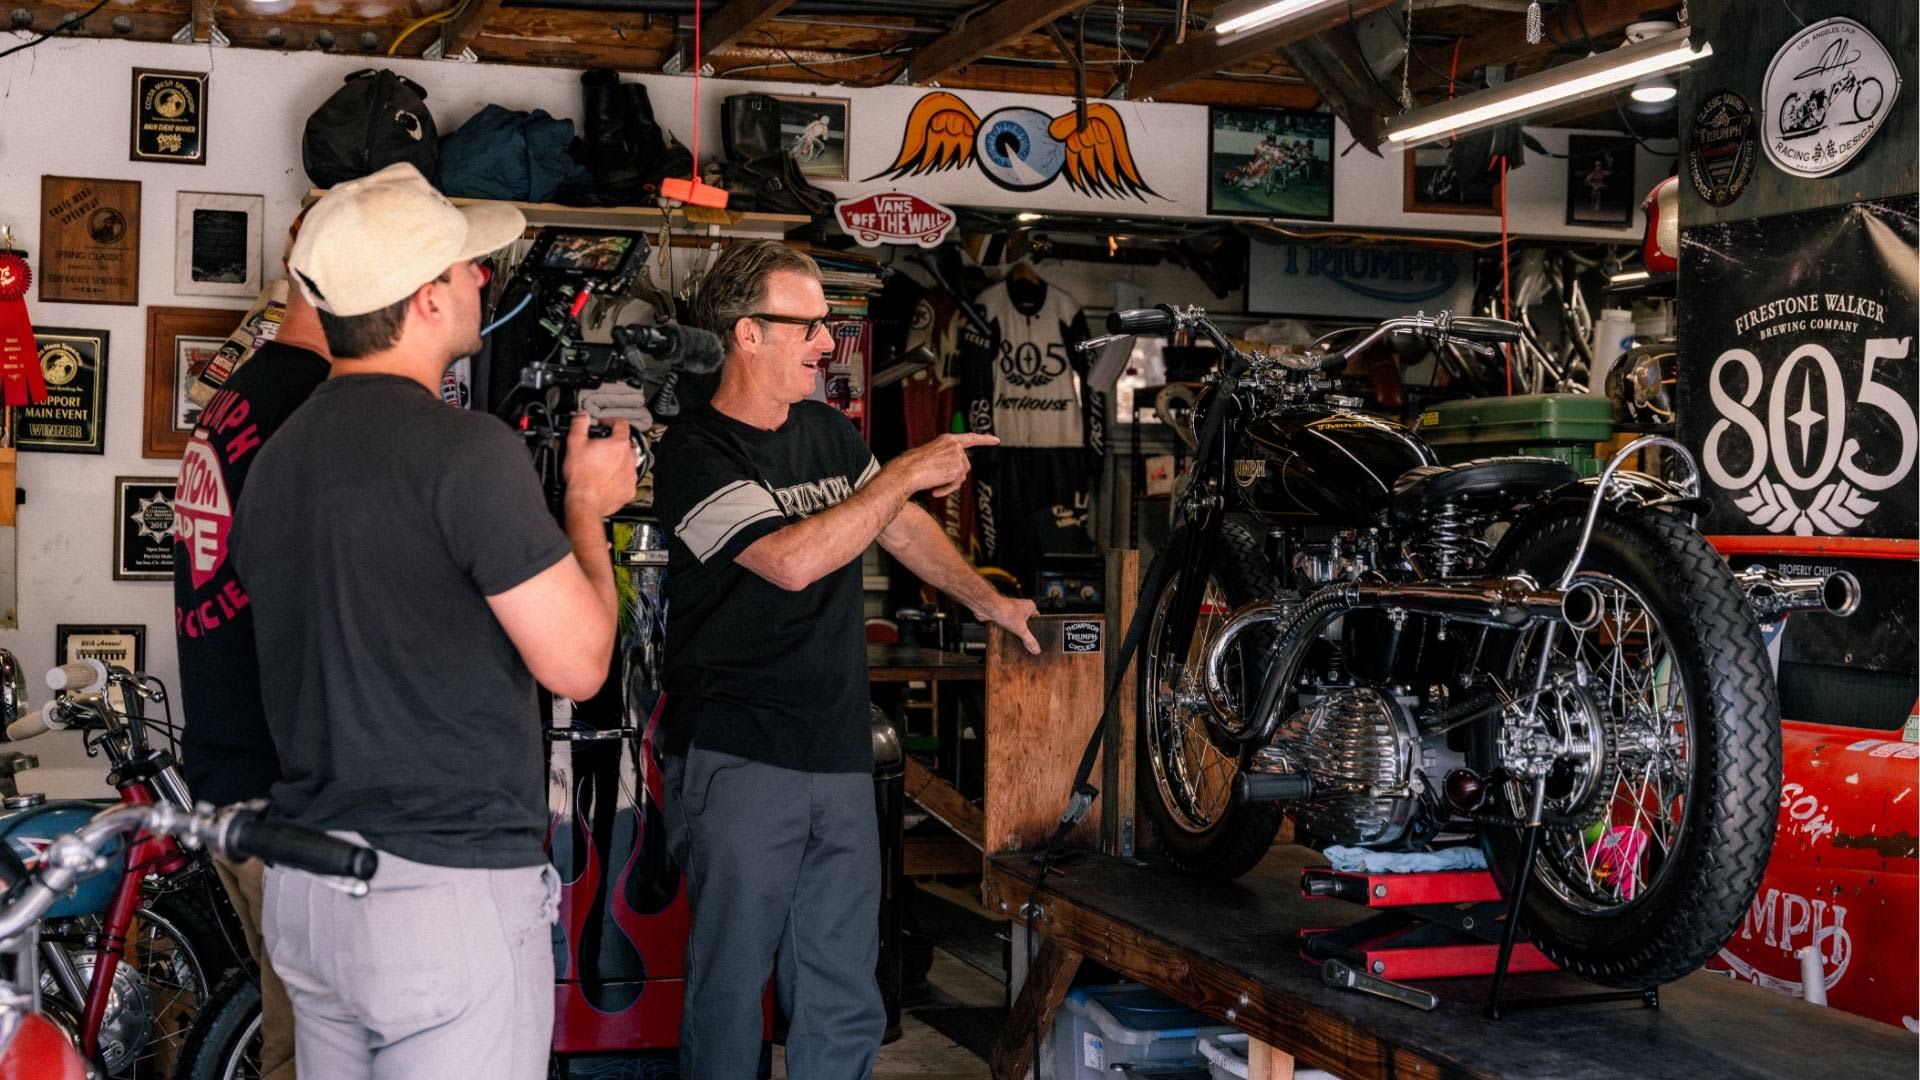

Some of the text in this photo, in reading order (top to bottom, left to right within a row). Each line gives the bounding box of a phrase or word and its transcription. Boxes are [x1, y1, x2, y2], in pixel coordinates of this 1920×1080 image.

[1797, 39, 1810, 50] LOS
[1812, 27, 1840, 40] ANGELES
[158, 123, 175, 132] EVENT
[1696, 125, 1742, 143] TRIUMPH
[1775, 121, 1876, 162] RACING DESIGN
[873, 197, 913, 214] VANS
[878, 213, 907, 234] THE
[55, 249, 86, 260] SPRING
[1735, 294, 1885, 336] FIRESTONE WALKER
[1759, 318, 1859, 341] BREWING COMPANY
[999, 339, 1067, 378] 805
[24, 407, 88, 420] MAIN EVENT
[1702, 336, 1918, 491] 805
[28, 422, 82, 439] WINNER
[175, 450, 219, 508] STOM
[1779, 563, 1813, 576] PROPERLY
[1065, 623, 1100, 632] THOMPSON
[1066, 632, 1098, 643] TRIUMPH
[1069, 643, 1096, 651] CYCLES
